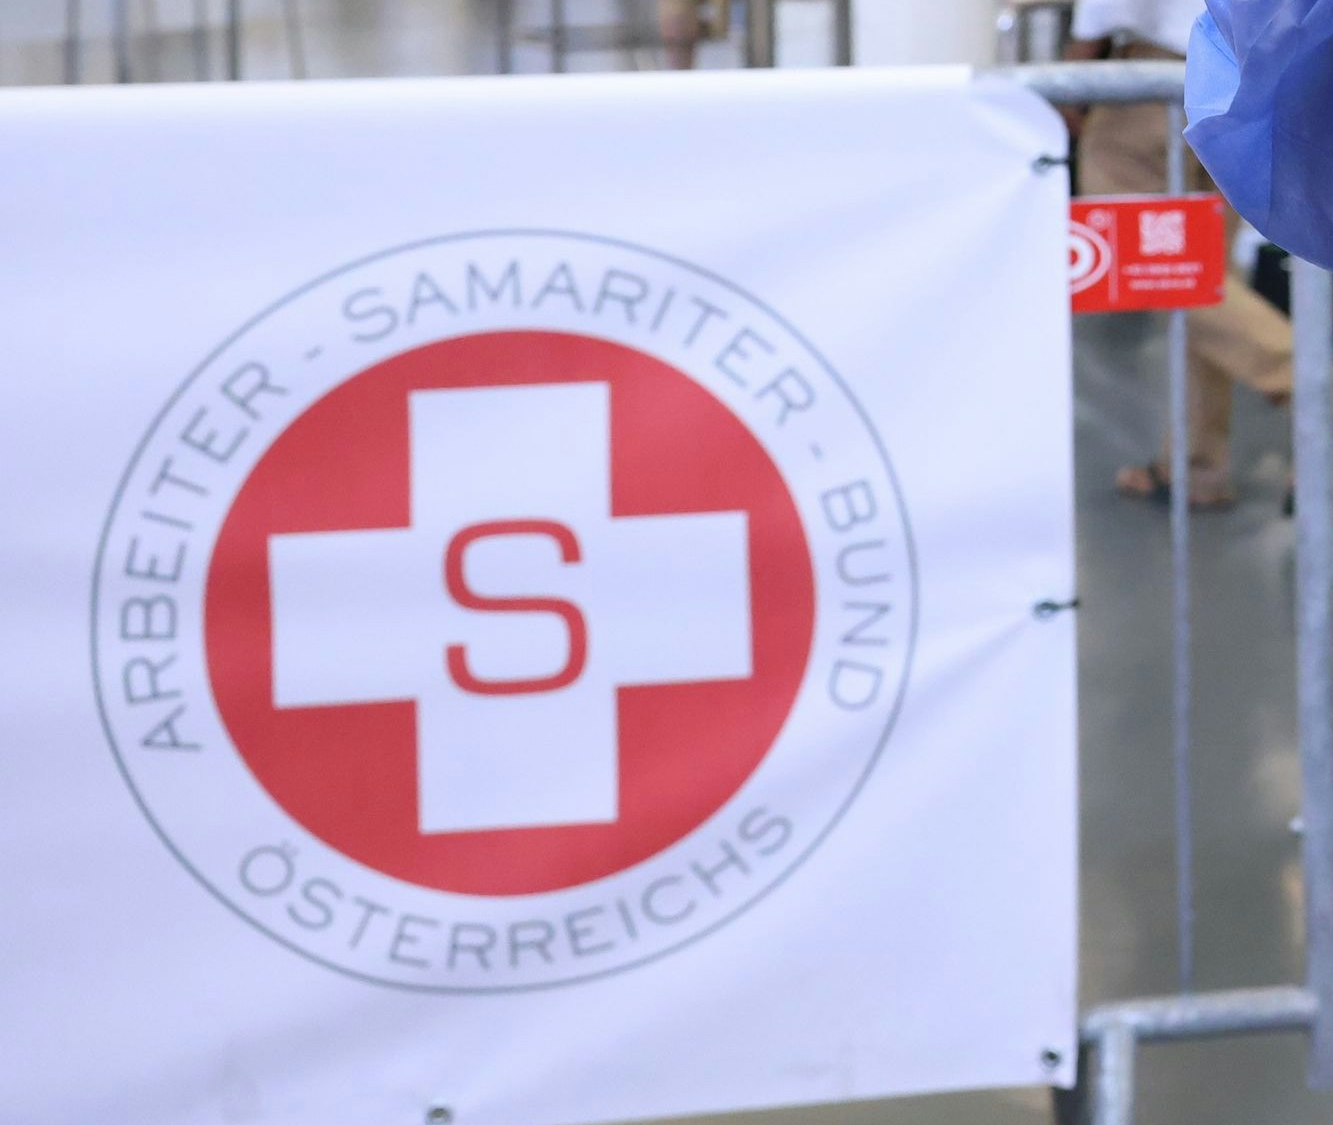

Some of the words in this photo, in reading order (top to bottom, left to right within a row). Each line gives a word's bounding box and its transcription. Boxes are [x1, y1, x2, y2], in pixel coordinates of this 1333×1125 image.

[120, 357, 290, 755] ARBEITER
[341, 259, 816, 427] SAMARITER
[819, 478, 893, 713] BUND
[441, 516, 589, 698] S
[237, 803, 795, 974] ÖSTERREICHS
